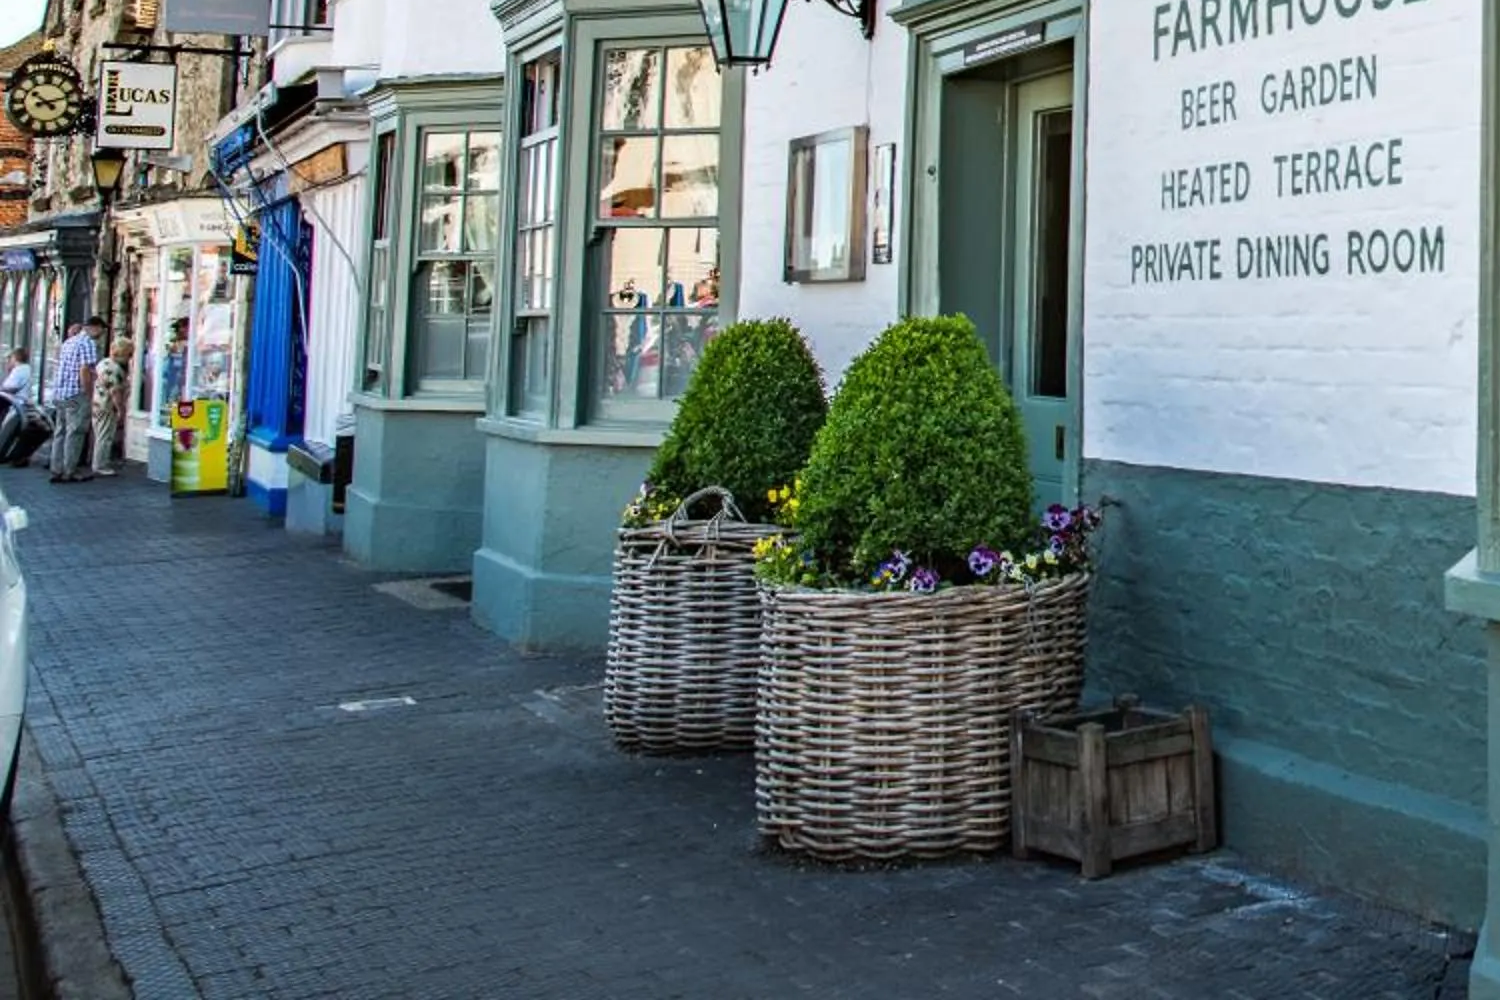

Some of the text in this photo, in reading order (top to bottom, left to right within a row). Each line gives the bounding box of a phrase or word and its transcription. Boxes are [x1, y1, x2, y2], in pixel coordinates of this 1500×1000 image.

[1181, 54, 1378, 130] BEER GARDEN
[1161, 138, 1403, 210] HEATED TERRACE
[1131, 225, 1446, 284] PRIVATE DINING ROOM
